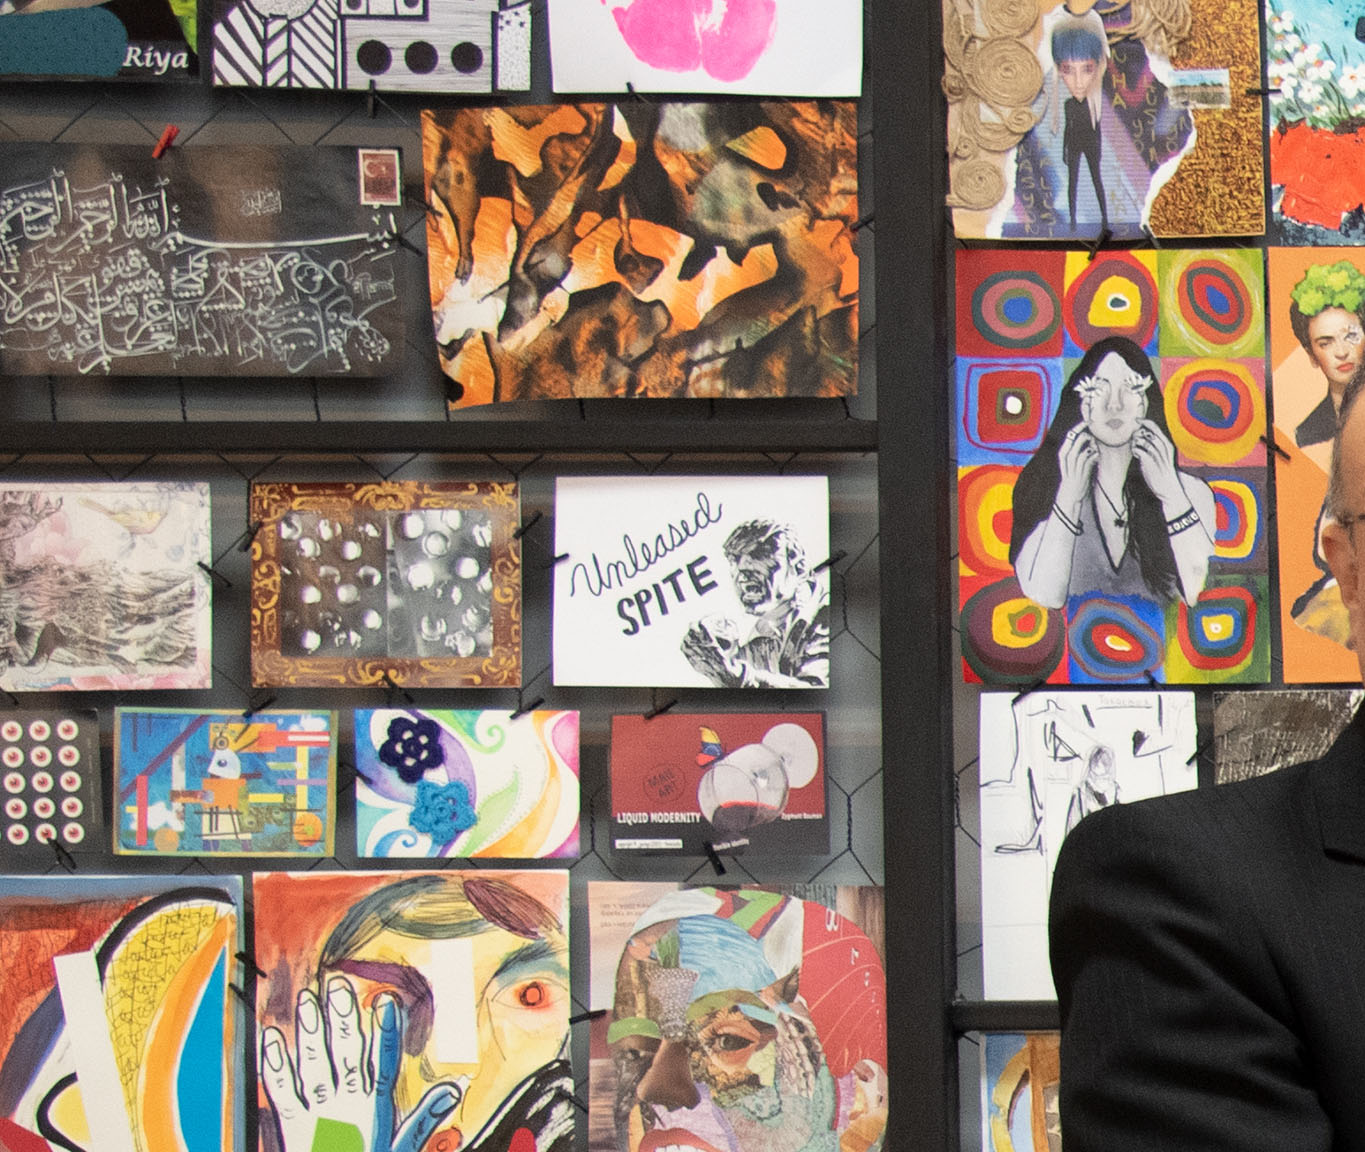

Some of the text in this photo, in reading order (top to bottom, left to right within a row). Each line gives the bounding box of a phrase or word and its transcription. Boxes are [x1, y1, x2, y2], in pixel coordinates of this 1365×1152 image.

[122, 46, 189, 75] Riya
[570, 492, 722, 597] Unleased
[617, 555, 718, 636] SPITE
[617, 811, 701, 826] LIQUID MODERNITY
